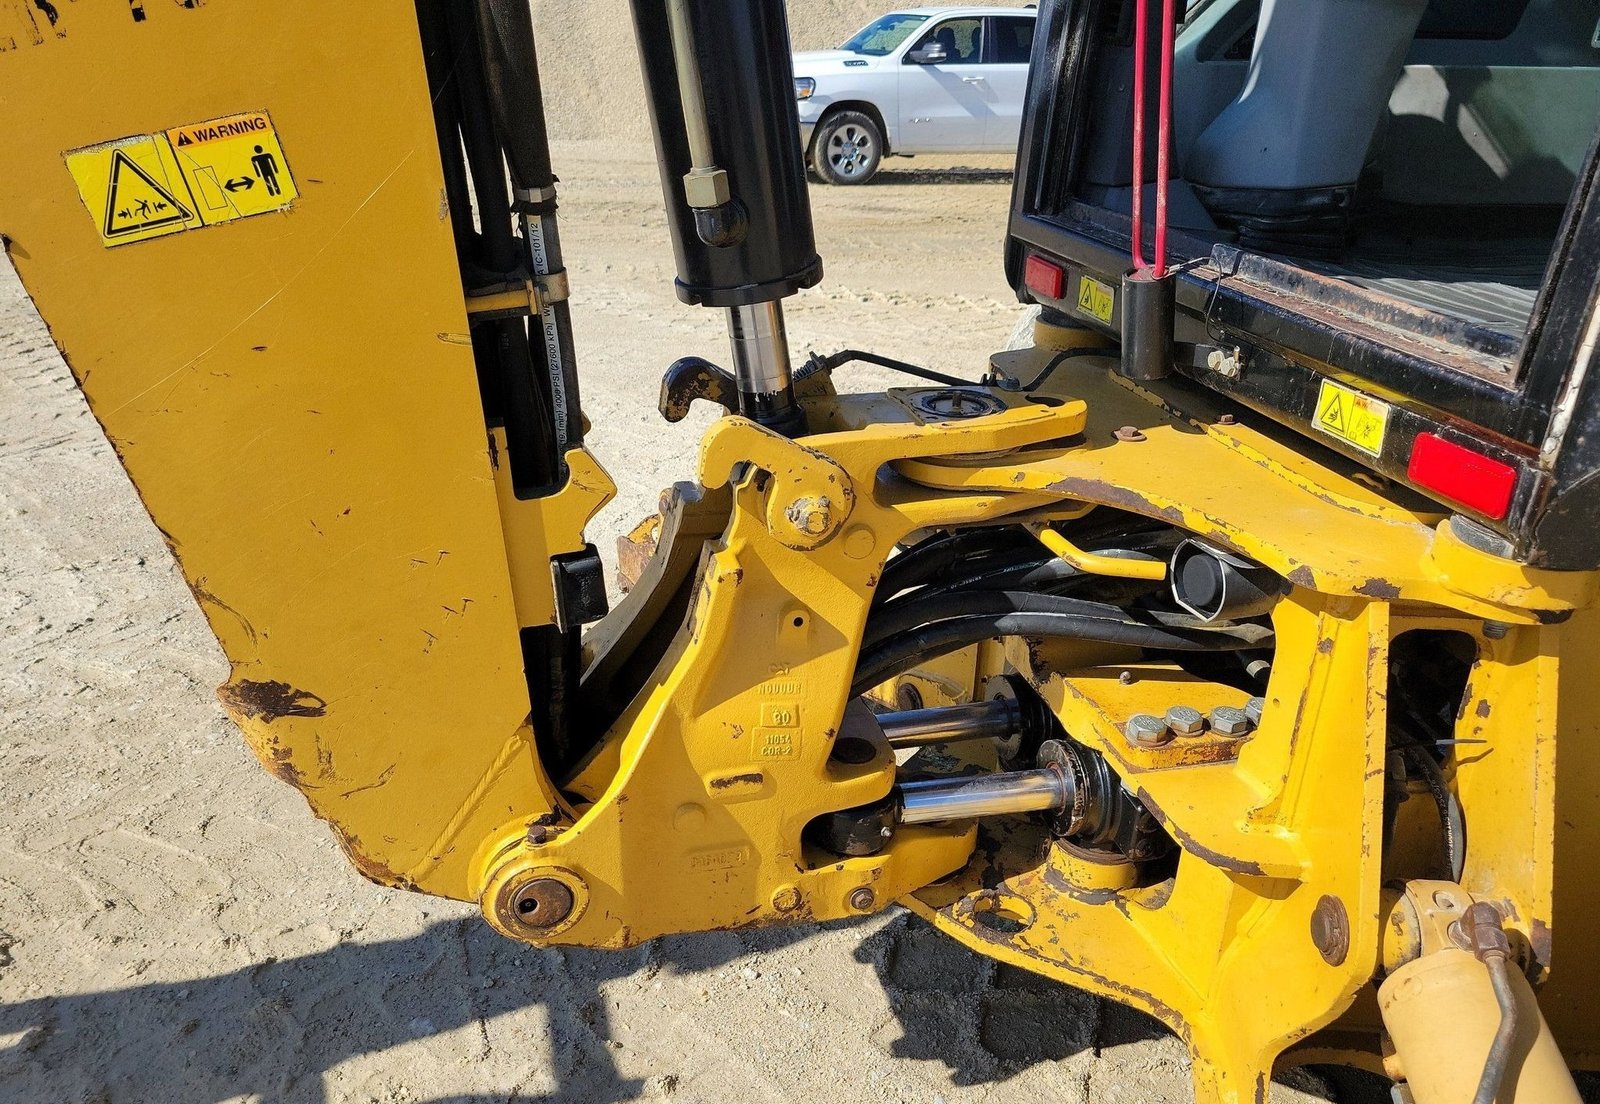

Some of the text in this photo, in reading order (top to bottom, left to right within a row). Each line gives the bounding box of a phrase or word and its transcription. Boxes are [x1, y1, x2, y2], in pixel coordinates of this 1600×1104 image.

[193, 118, 266, 142] WARNING
[531, 223, 544, 267] IC-101/12
[549, 344, 559, 370] (27600
[552, 373, 560, 388] PSI
